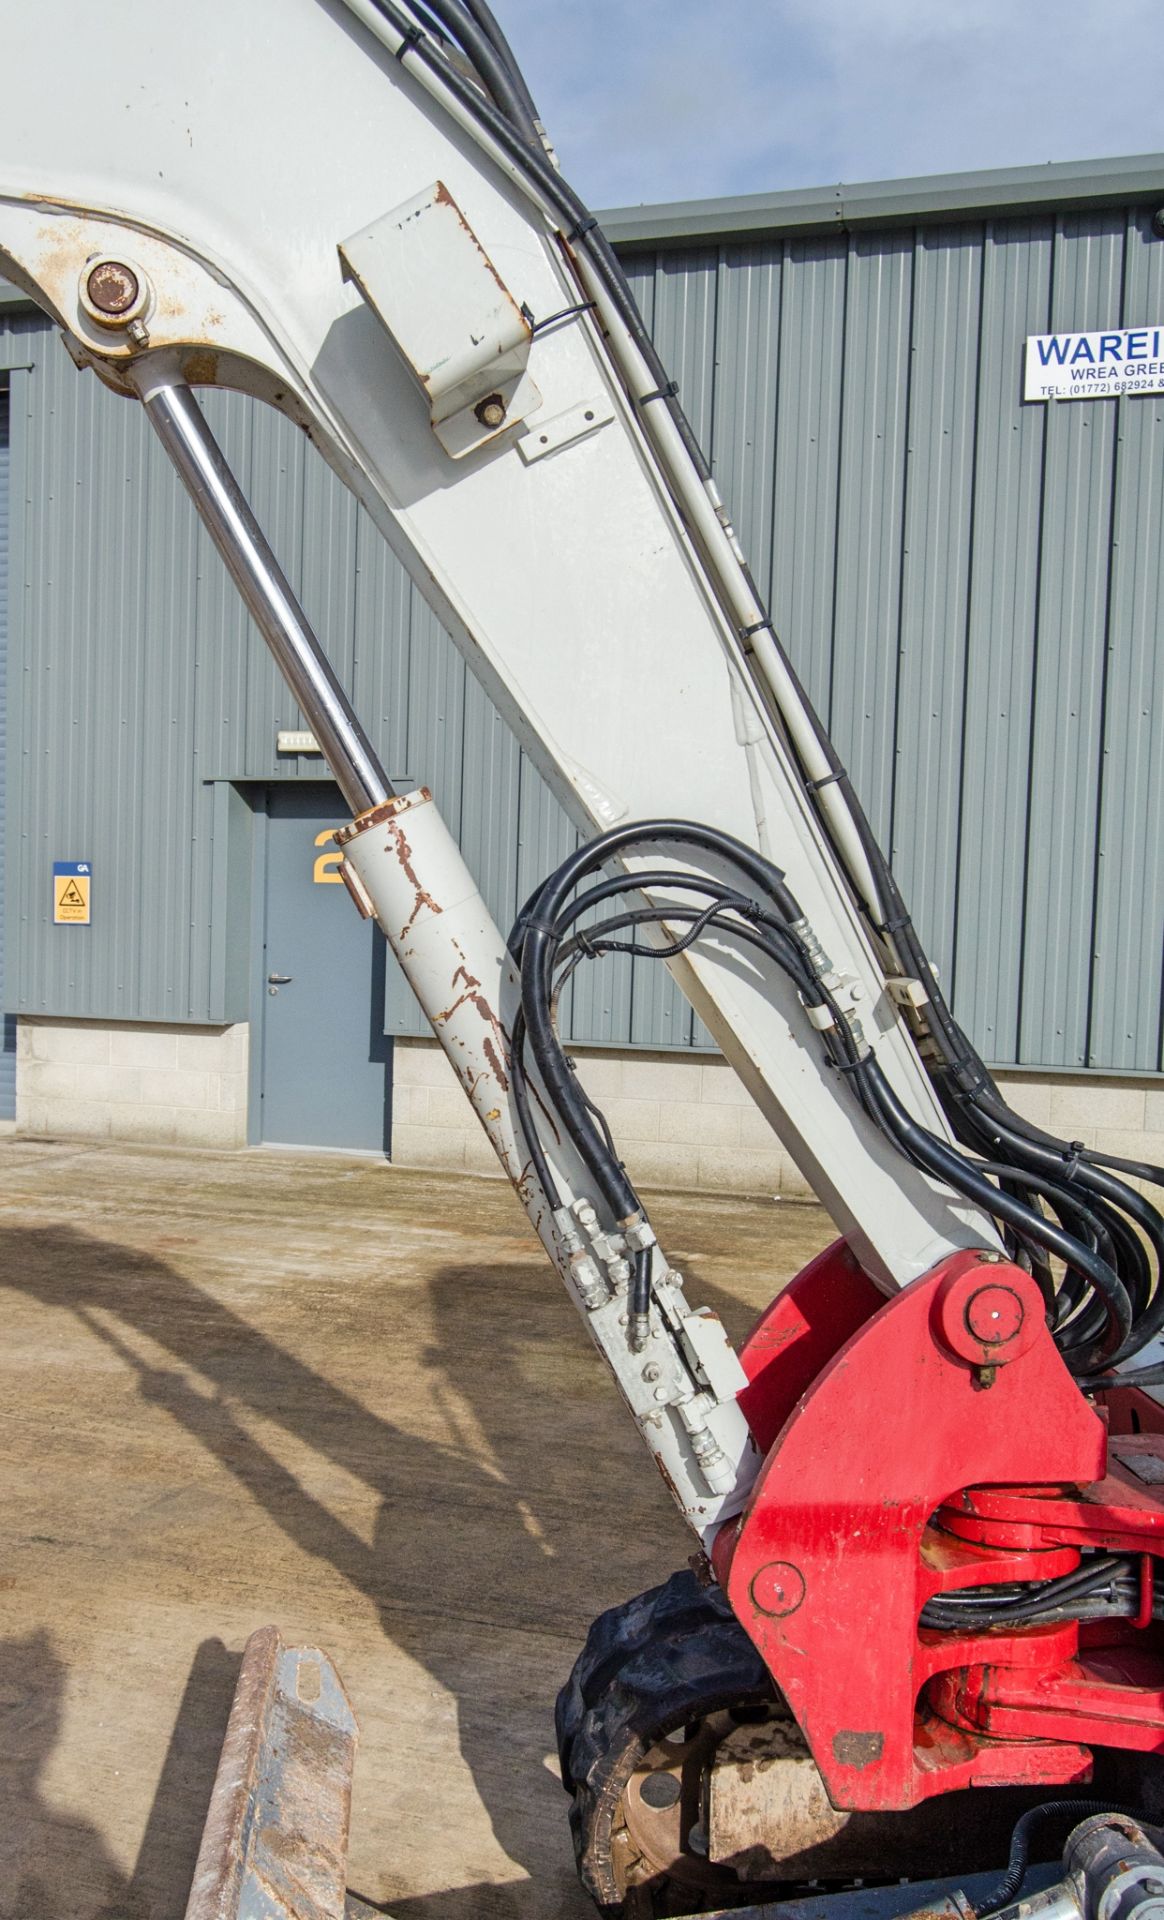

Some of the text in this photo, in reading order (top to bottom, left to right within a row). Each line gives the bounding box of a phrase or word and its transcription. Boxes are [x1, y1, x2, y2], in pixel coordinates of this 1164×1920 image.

[1037, 331, 1160, 366] WAREI
[1071, 366, 1119, 380] WREA
[1040, 386, 1066, 395] TEL:
[1069, 383, 1111, 396] (01772)
[1114, 379, 1154, 391] 682924
[77, 864, 89, 872] GA
